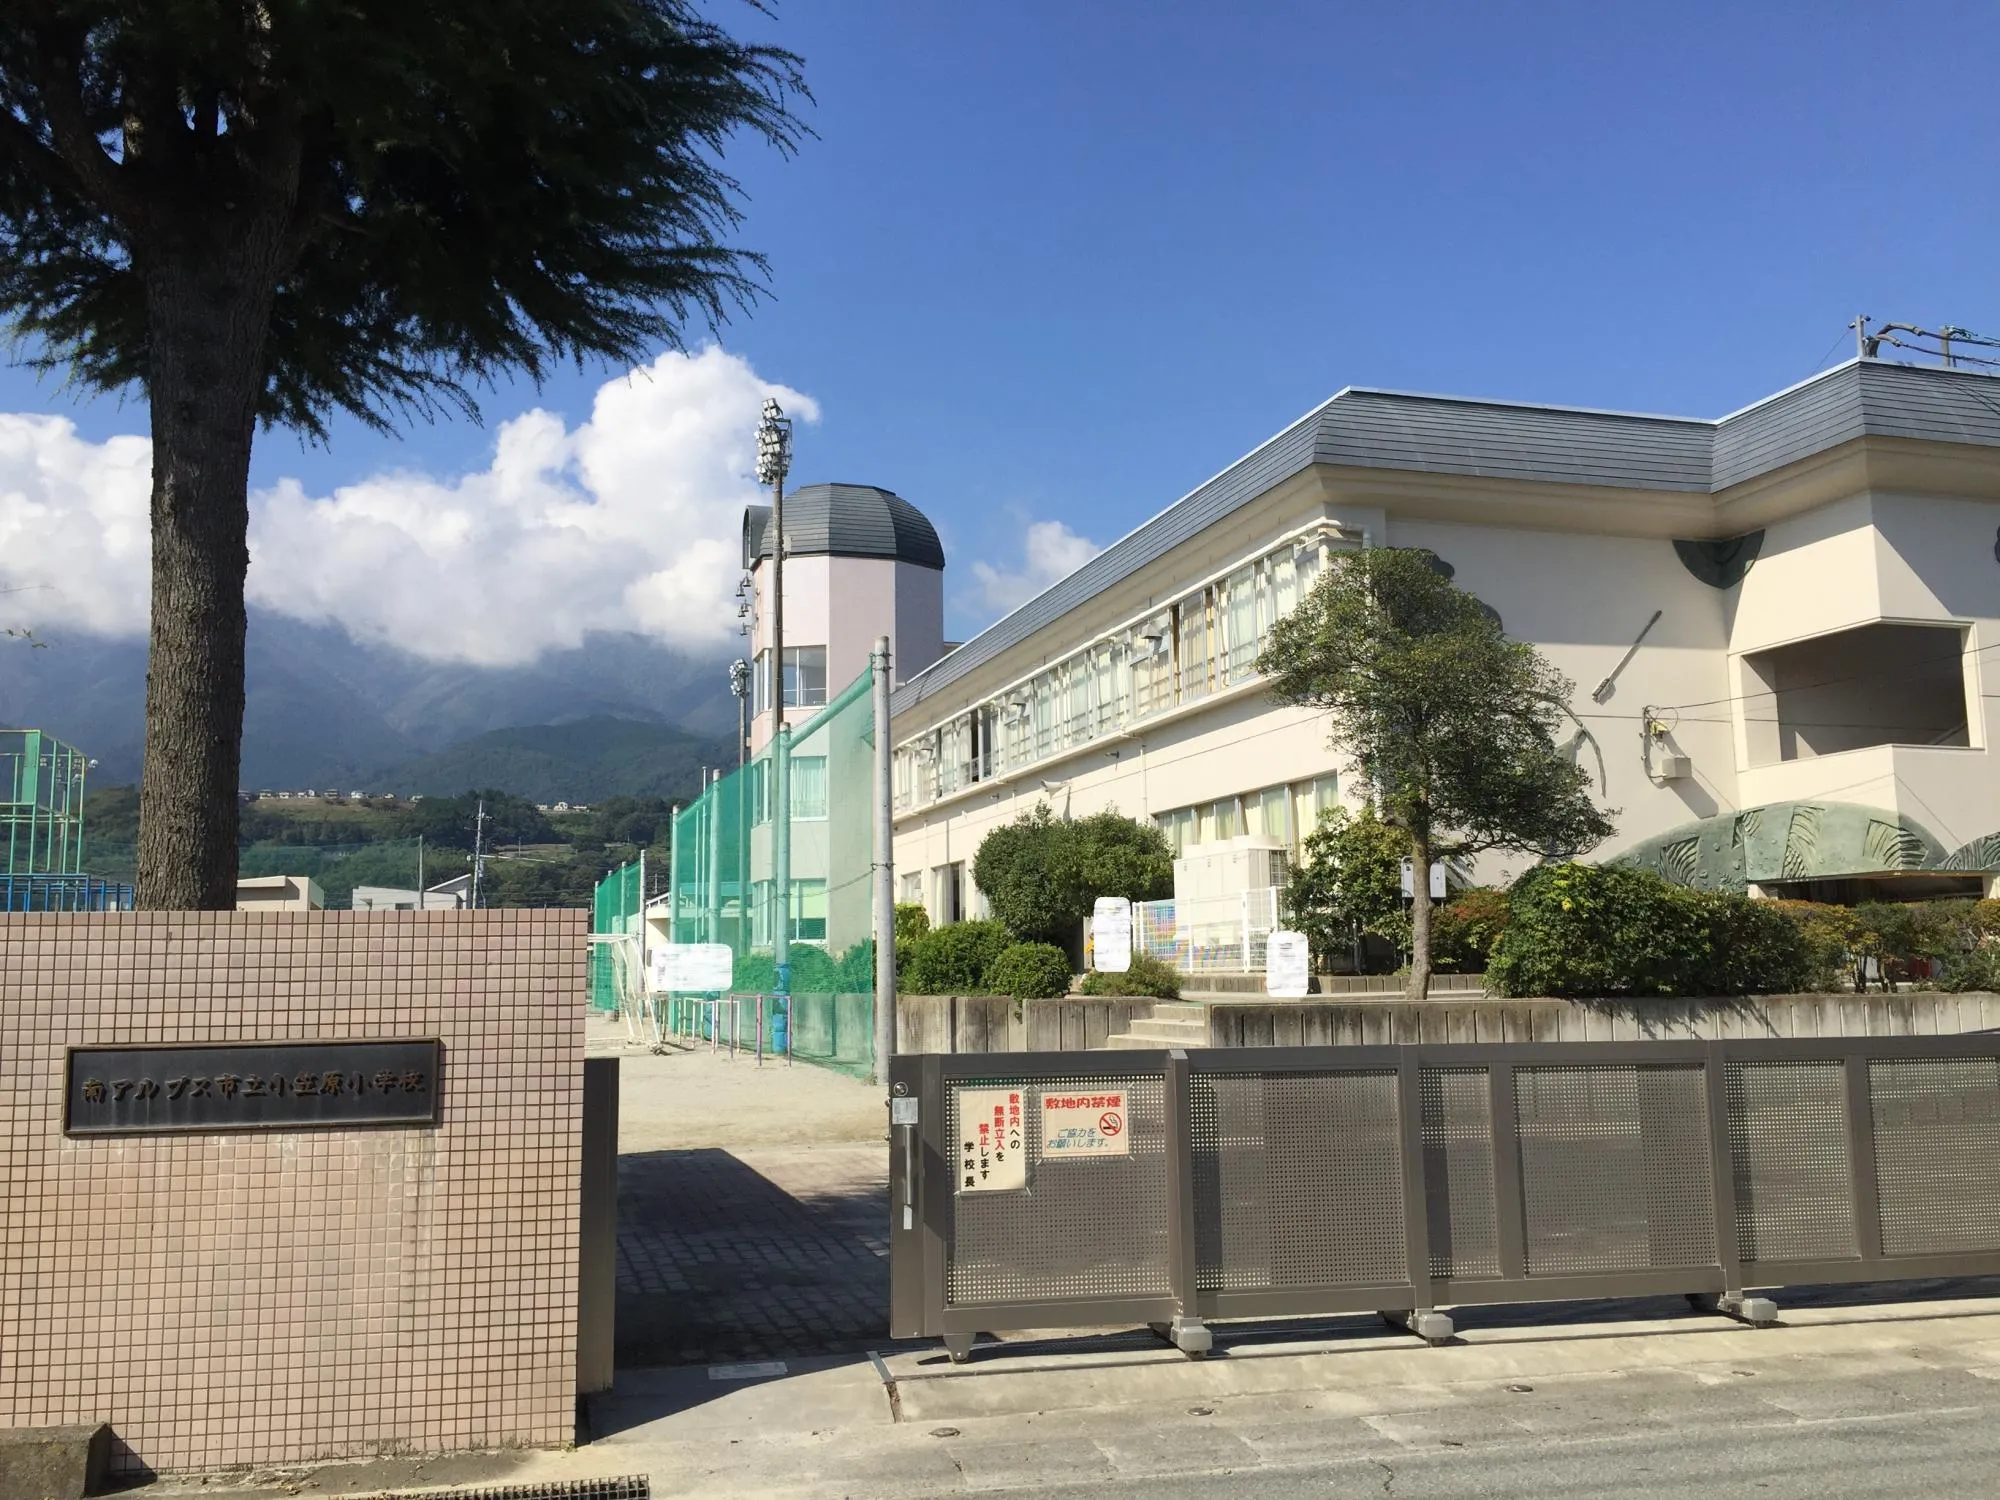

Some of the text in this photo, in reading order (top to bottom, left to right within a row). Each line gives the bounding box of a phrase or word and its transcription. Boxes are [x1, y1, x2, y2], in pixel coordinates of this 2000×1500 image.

[81, 1067, 427, 1104] 南アルプス市立小笠原小学校
[1045, 1095, 1121, 1109] 敷地内禁煙
[994, 1105, 1005, 1162] 無断立入を
[1009, 1093, 1021, 1149] 敷地内への
[964, 1141, 975, 1188] 学校長
[979, 1123, 990, 1180] 禁止します
